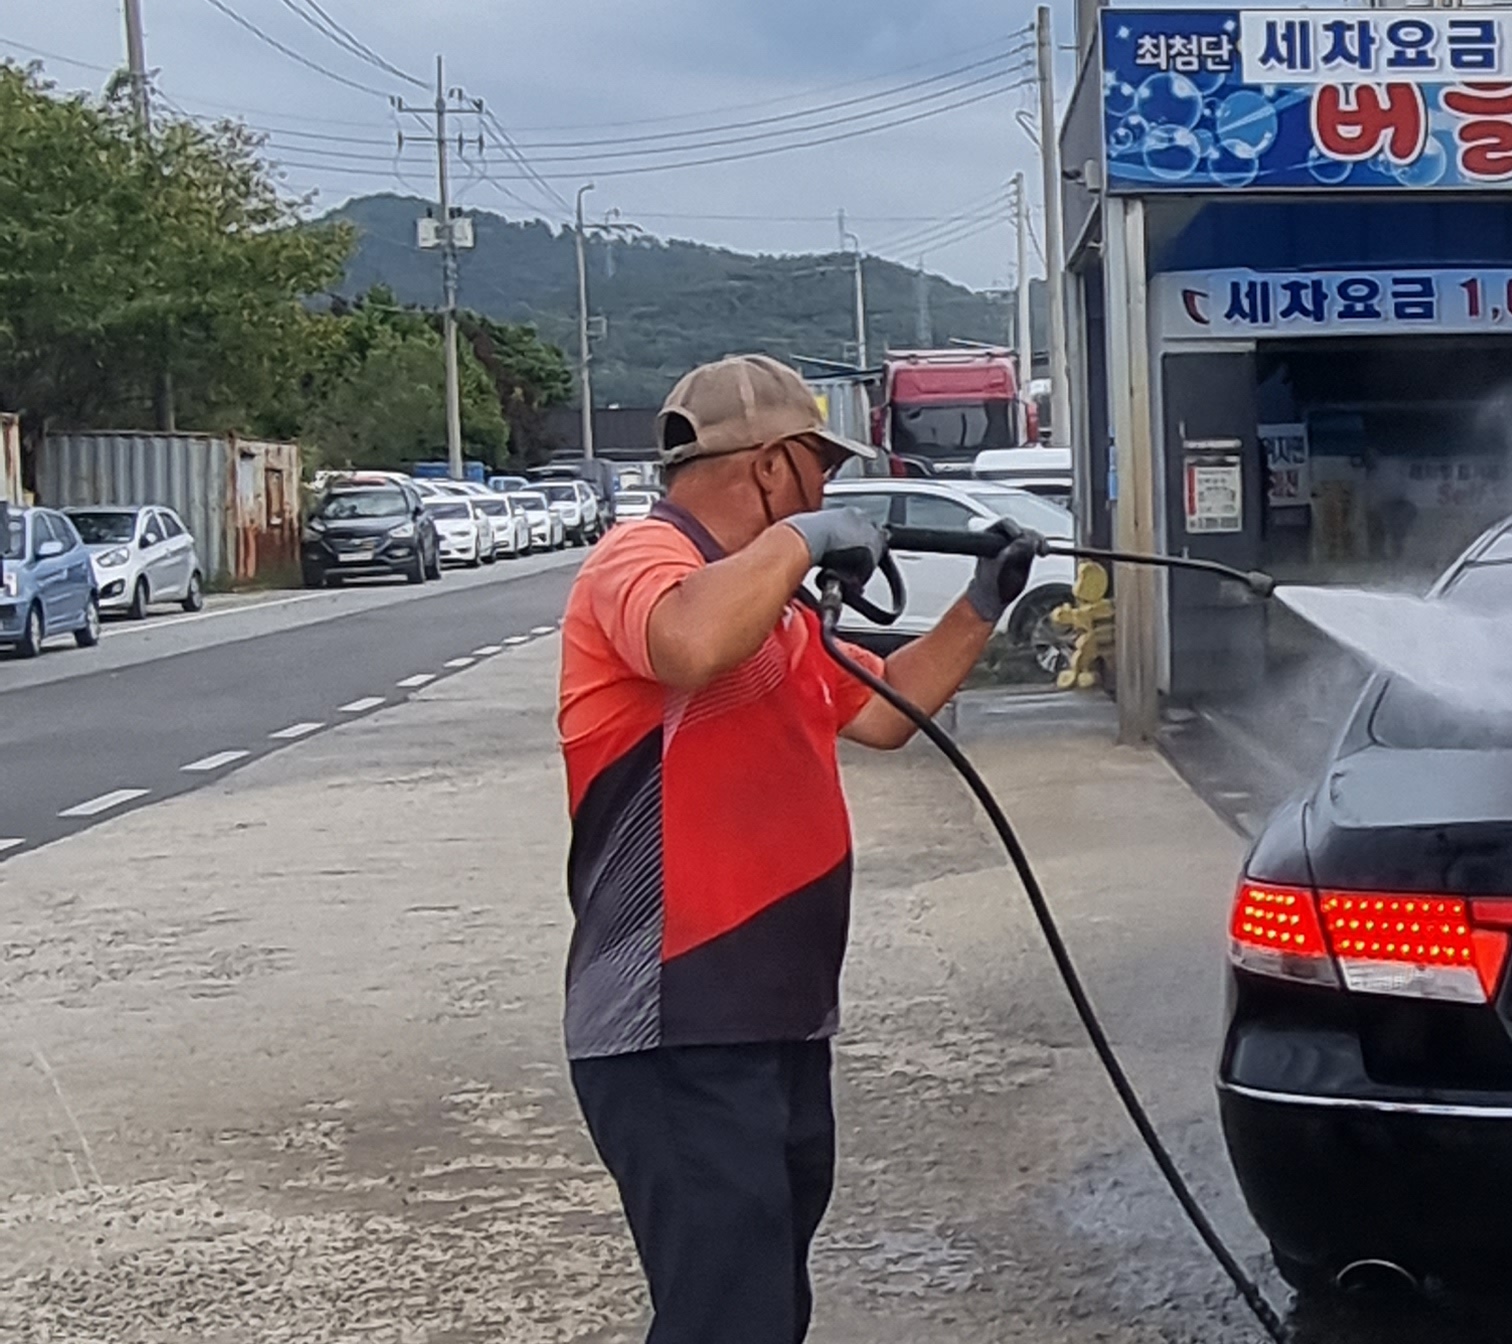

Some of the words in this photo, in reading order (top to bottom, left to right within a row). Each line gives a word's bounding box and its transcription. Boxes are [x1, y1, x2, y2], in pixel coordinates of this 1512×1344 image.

[1135, 34, 1233, 72] 최첨단
[1258, 18, 1497, 71] 세차요금
[1224, 276, 1437, 325] 세차요금
